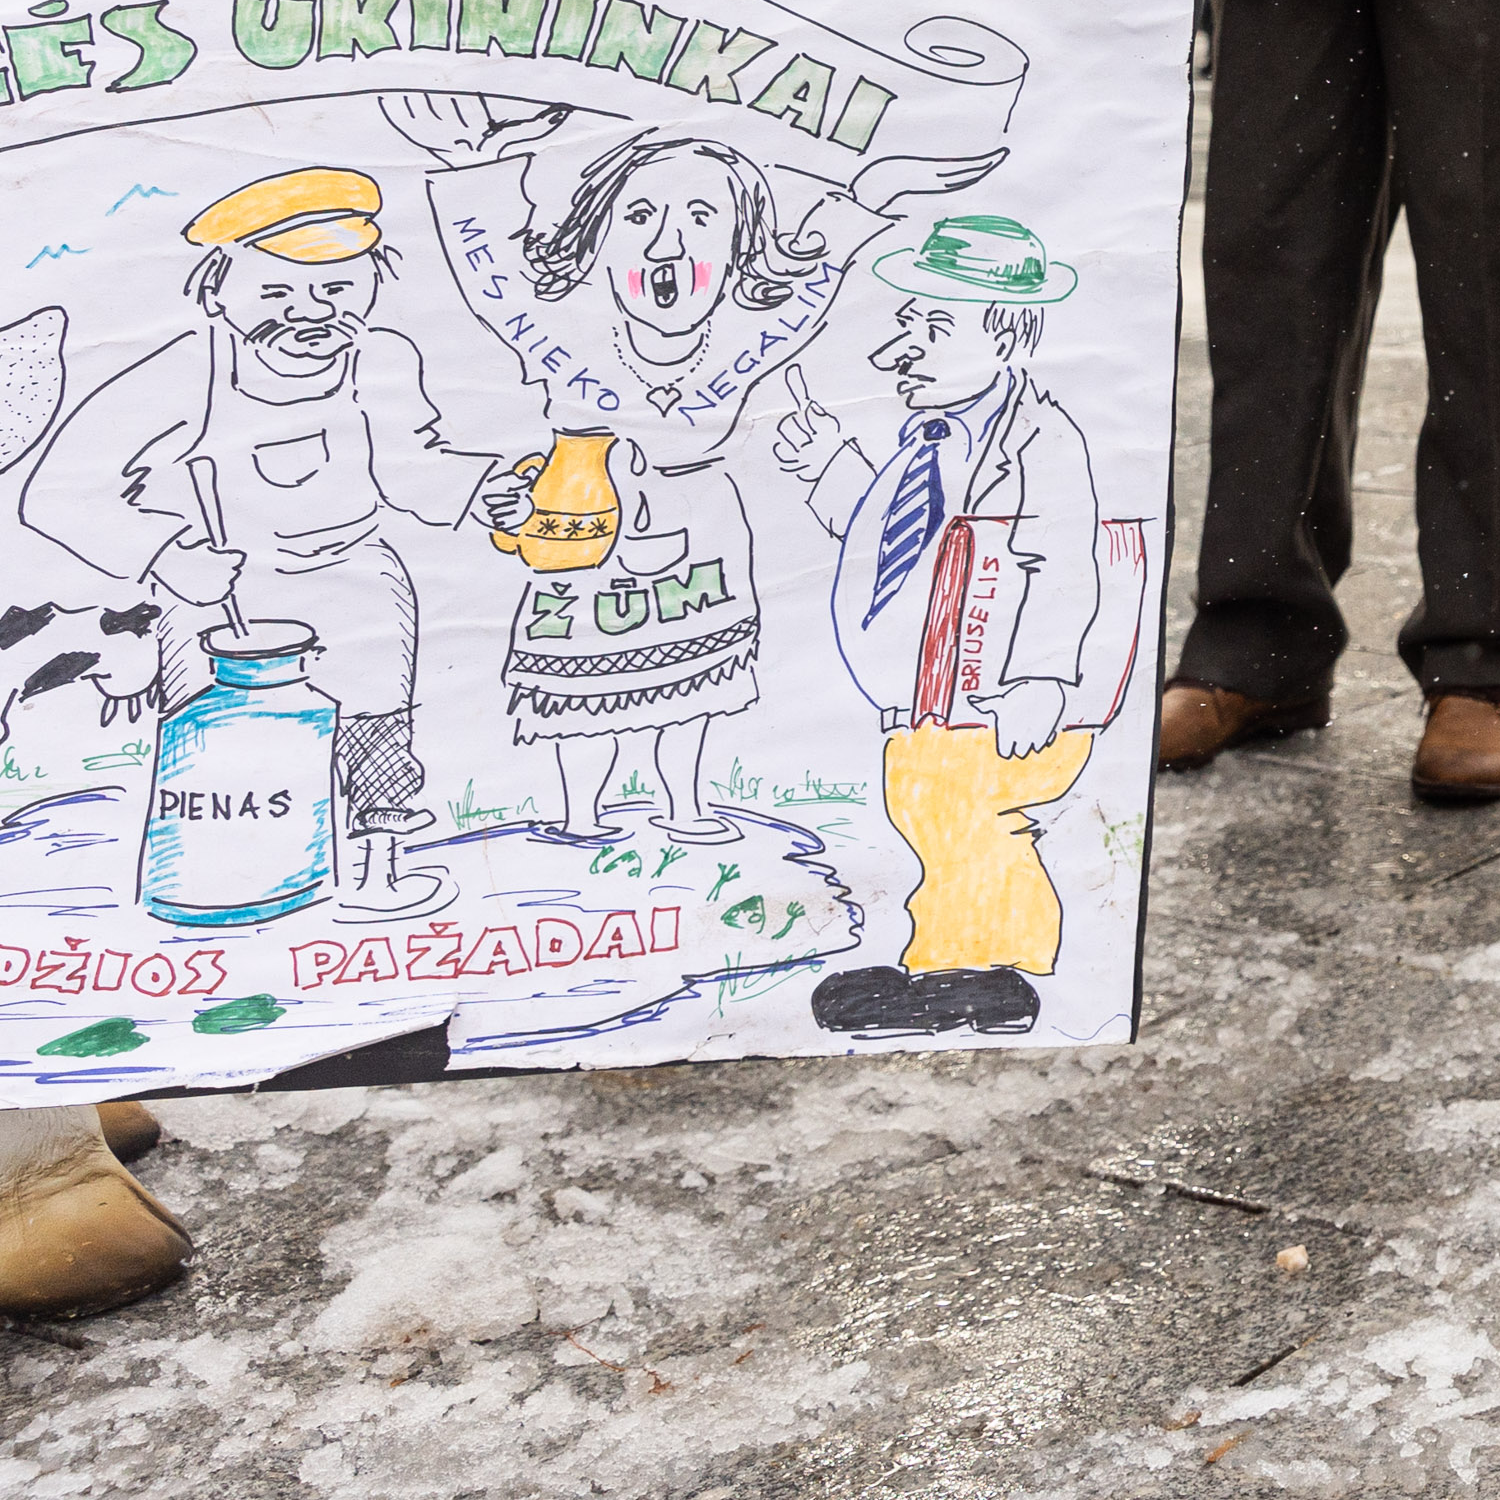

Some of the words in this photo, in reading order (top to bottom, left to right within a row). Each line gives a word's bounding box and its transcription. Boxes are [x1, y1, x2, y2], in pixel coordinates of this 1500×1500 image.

[452, 216, 508, 301] MES
[505, 312, 621, 412] NIEKO
[678, 261, 844, 427] NEGALIM
[525, 557, 737, 641] ŽŪM
[960, 555, 1000, 692] BRIUSELIS
[159, 788, 293, 820] PIENAS
[290, 905, 682, 991] PAŽADAI
